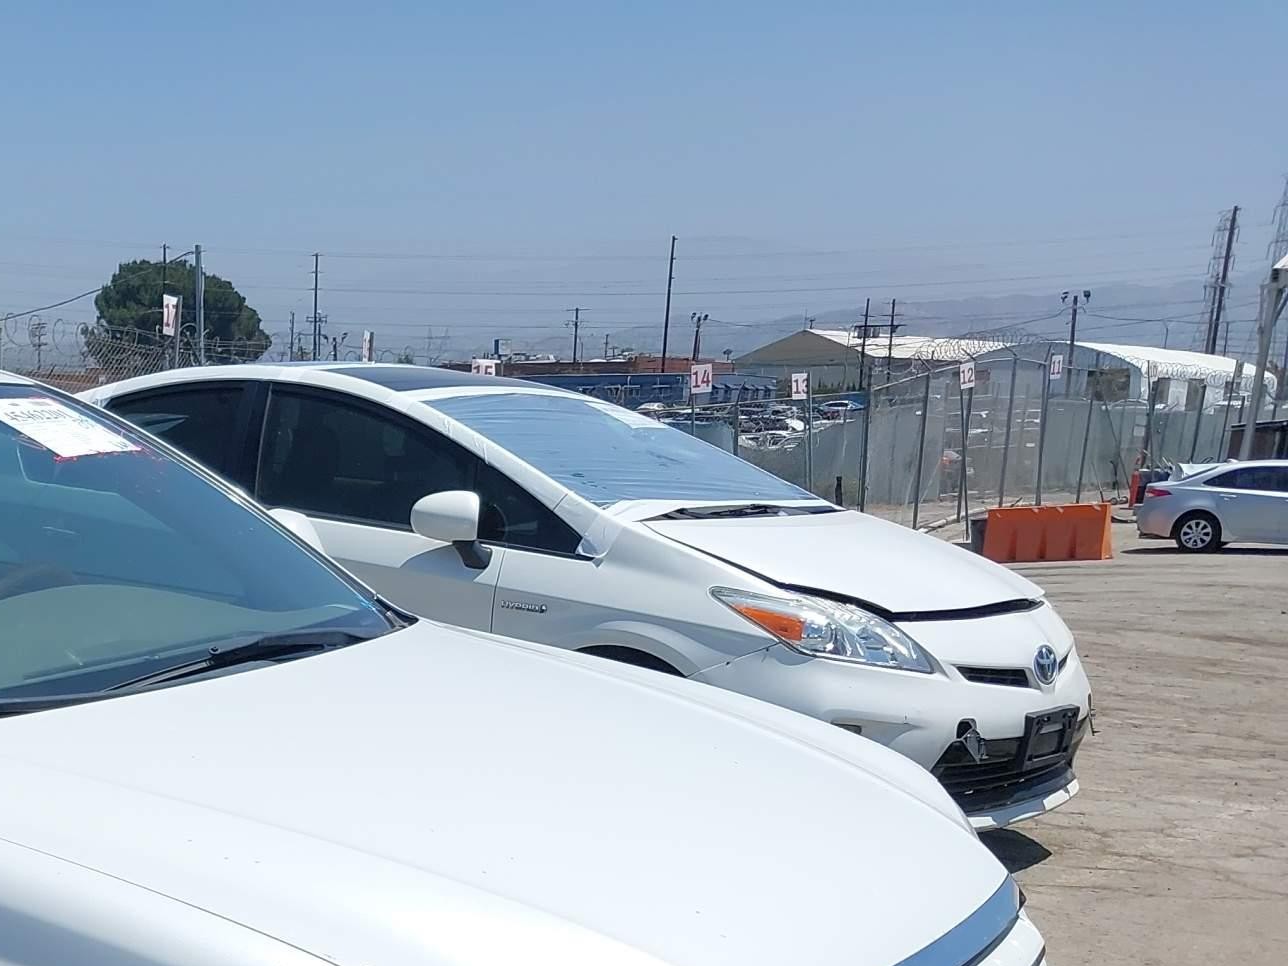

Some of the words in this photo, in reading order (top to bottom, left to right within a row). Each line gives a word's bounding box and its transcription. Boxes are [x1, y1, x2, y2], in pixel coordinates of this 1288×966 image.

[961, 367, 974, 385] 12
[1051, 359, 1062, 376] 11
[692, 369, 711, 388] 14
